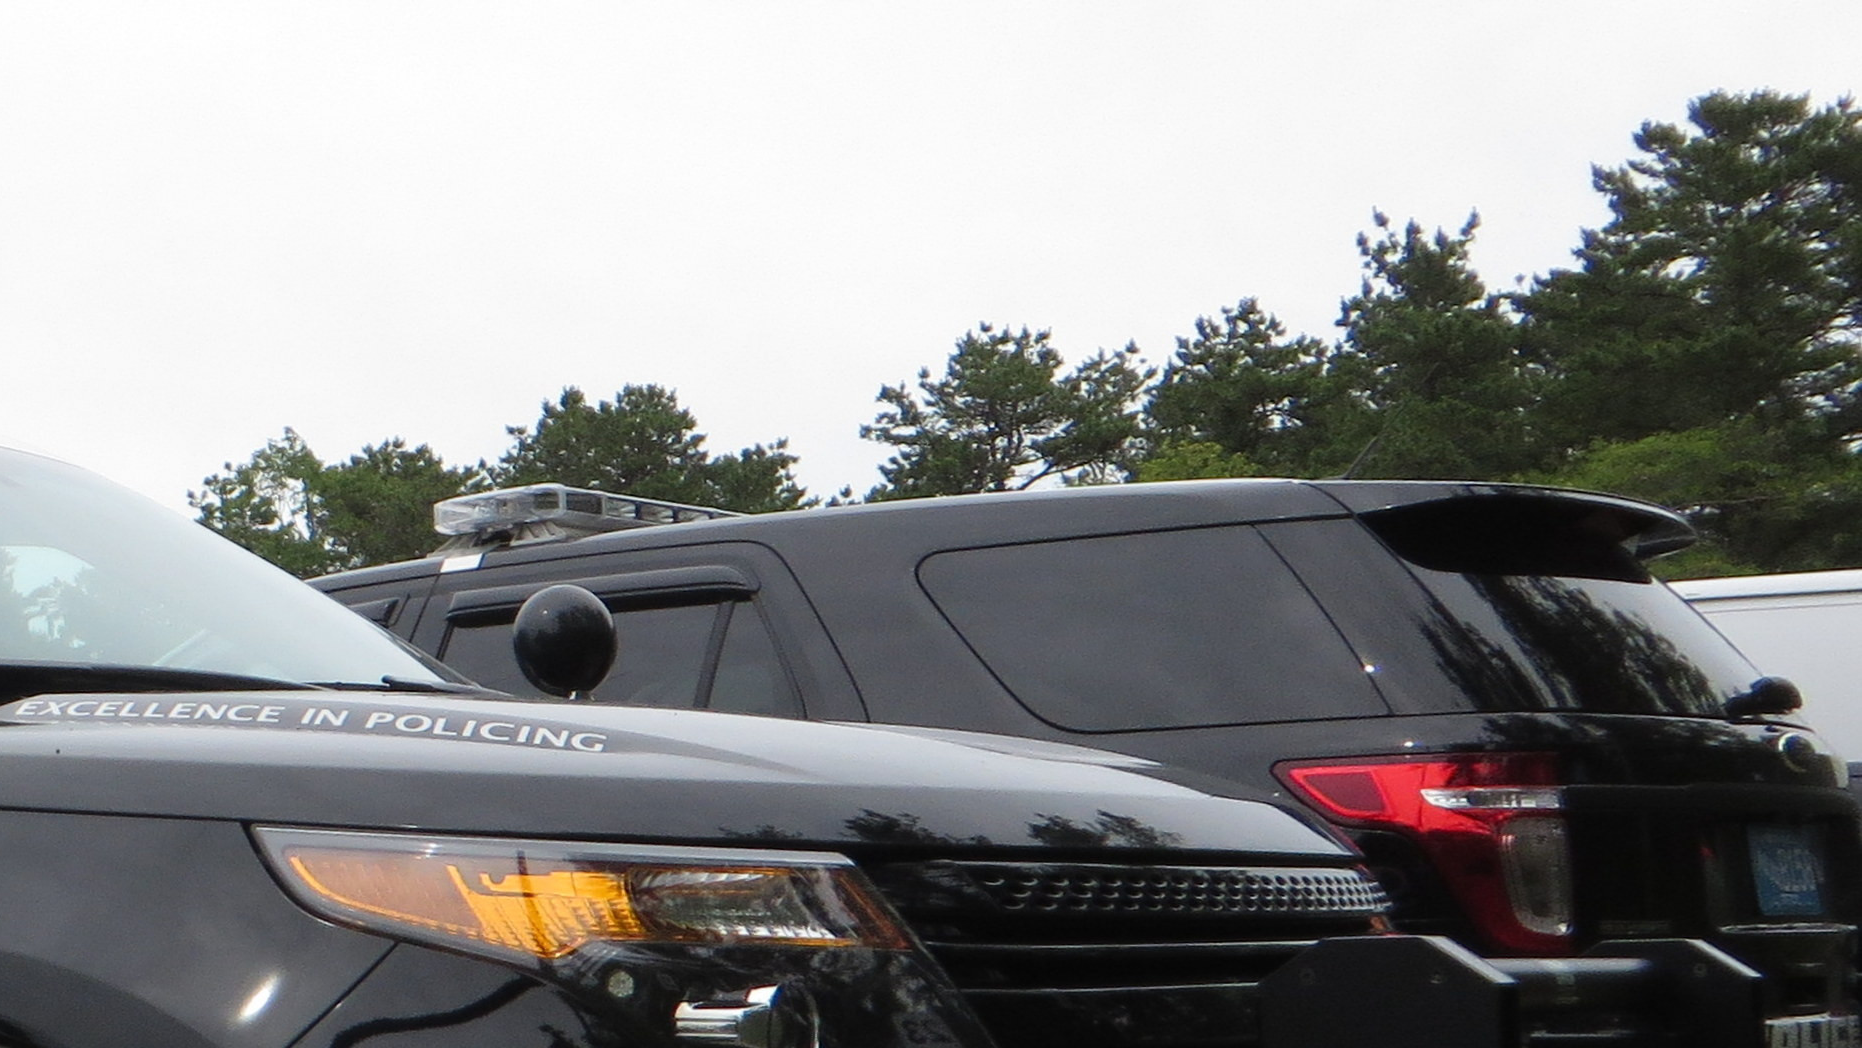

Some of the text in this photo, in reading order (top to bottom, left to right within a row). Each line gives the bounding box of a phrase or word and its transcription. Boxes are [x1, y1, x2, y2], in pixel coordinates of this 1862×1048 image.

[14, 700, 607, 753] EXCELLENCE IN POLICING
